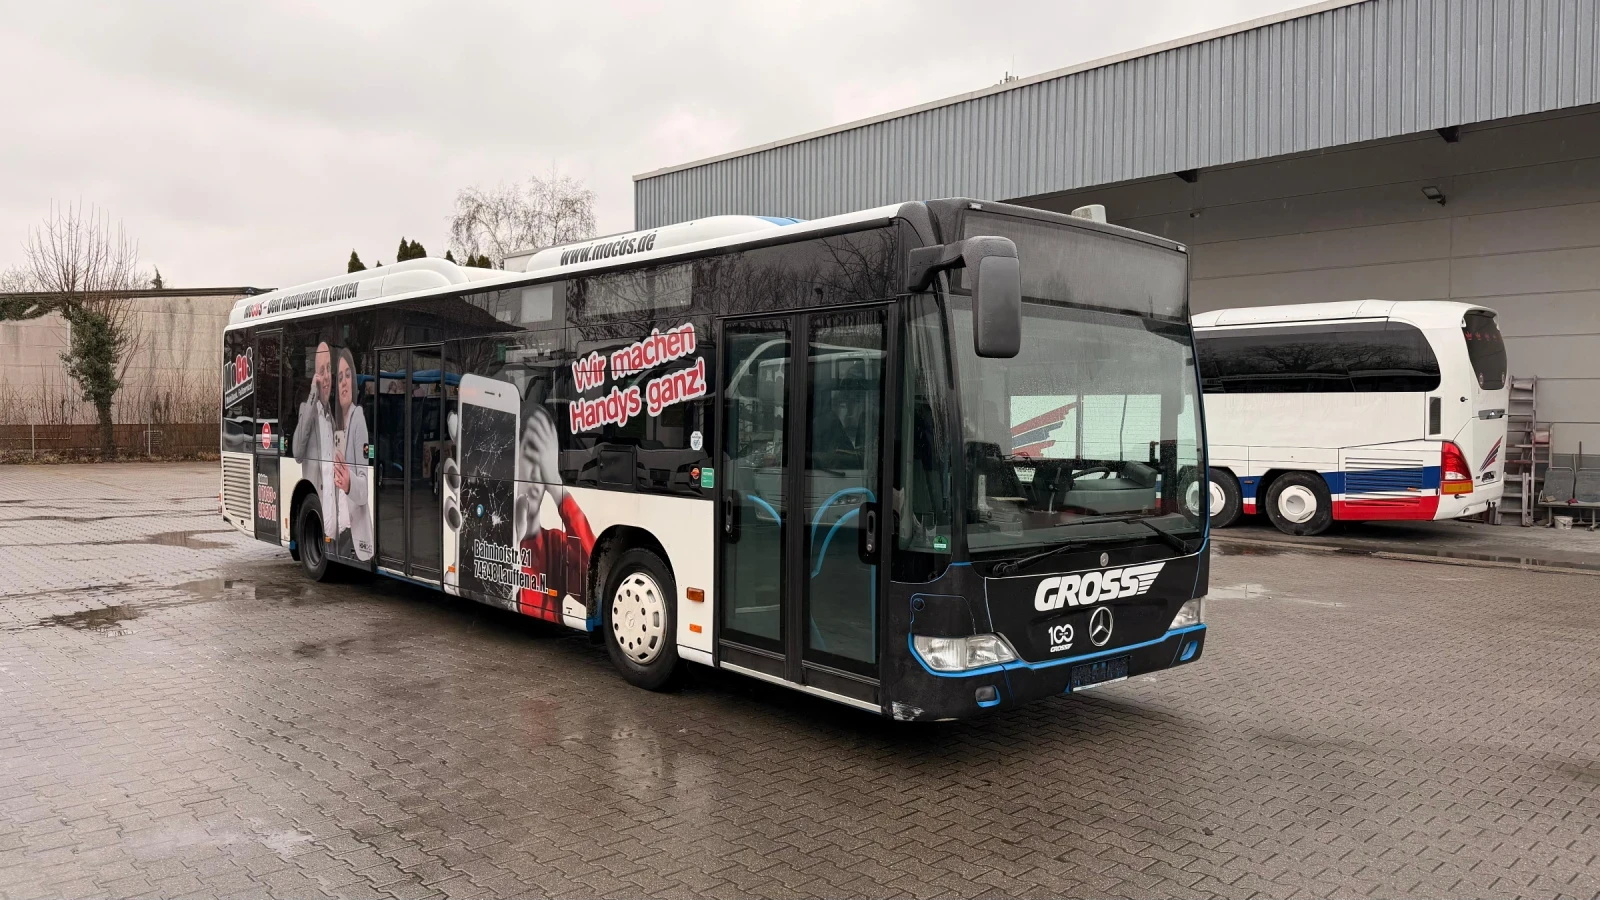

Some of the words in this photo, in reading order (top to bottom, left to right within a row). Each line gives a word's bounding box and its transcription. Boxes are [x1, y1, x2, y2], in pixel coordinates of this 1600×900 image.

[560, 230, 657, 267] www.mocos.de
[329, 281, 359, 303] Lauffen
[571, 352, 607, 392] Wir
[611, 322, 695, 377] machen
[570, 385, 641, 434] Handys
[646, 358, 706, 416] ganz!
[474, 539, 520, 565] Bahnhofstr.
[521, 548, 532, 568] 21
[474, 561, 498, 583] 74348
[498, 564, 530, 589] Lauffen
[531, 575, 539, 591] a.
[538, 572, 549, 595] N.
[1034, 562, 1166, 611] GROSS
[1048, 624, 1074, 646] 100
